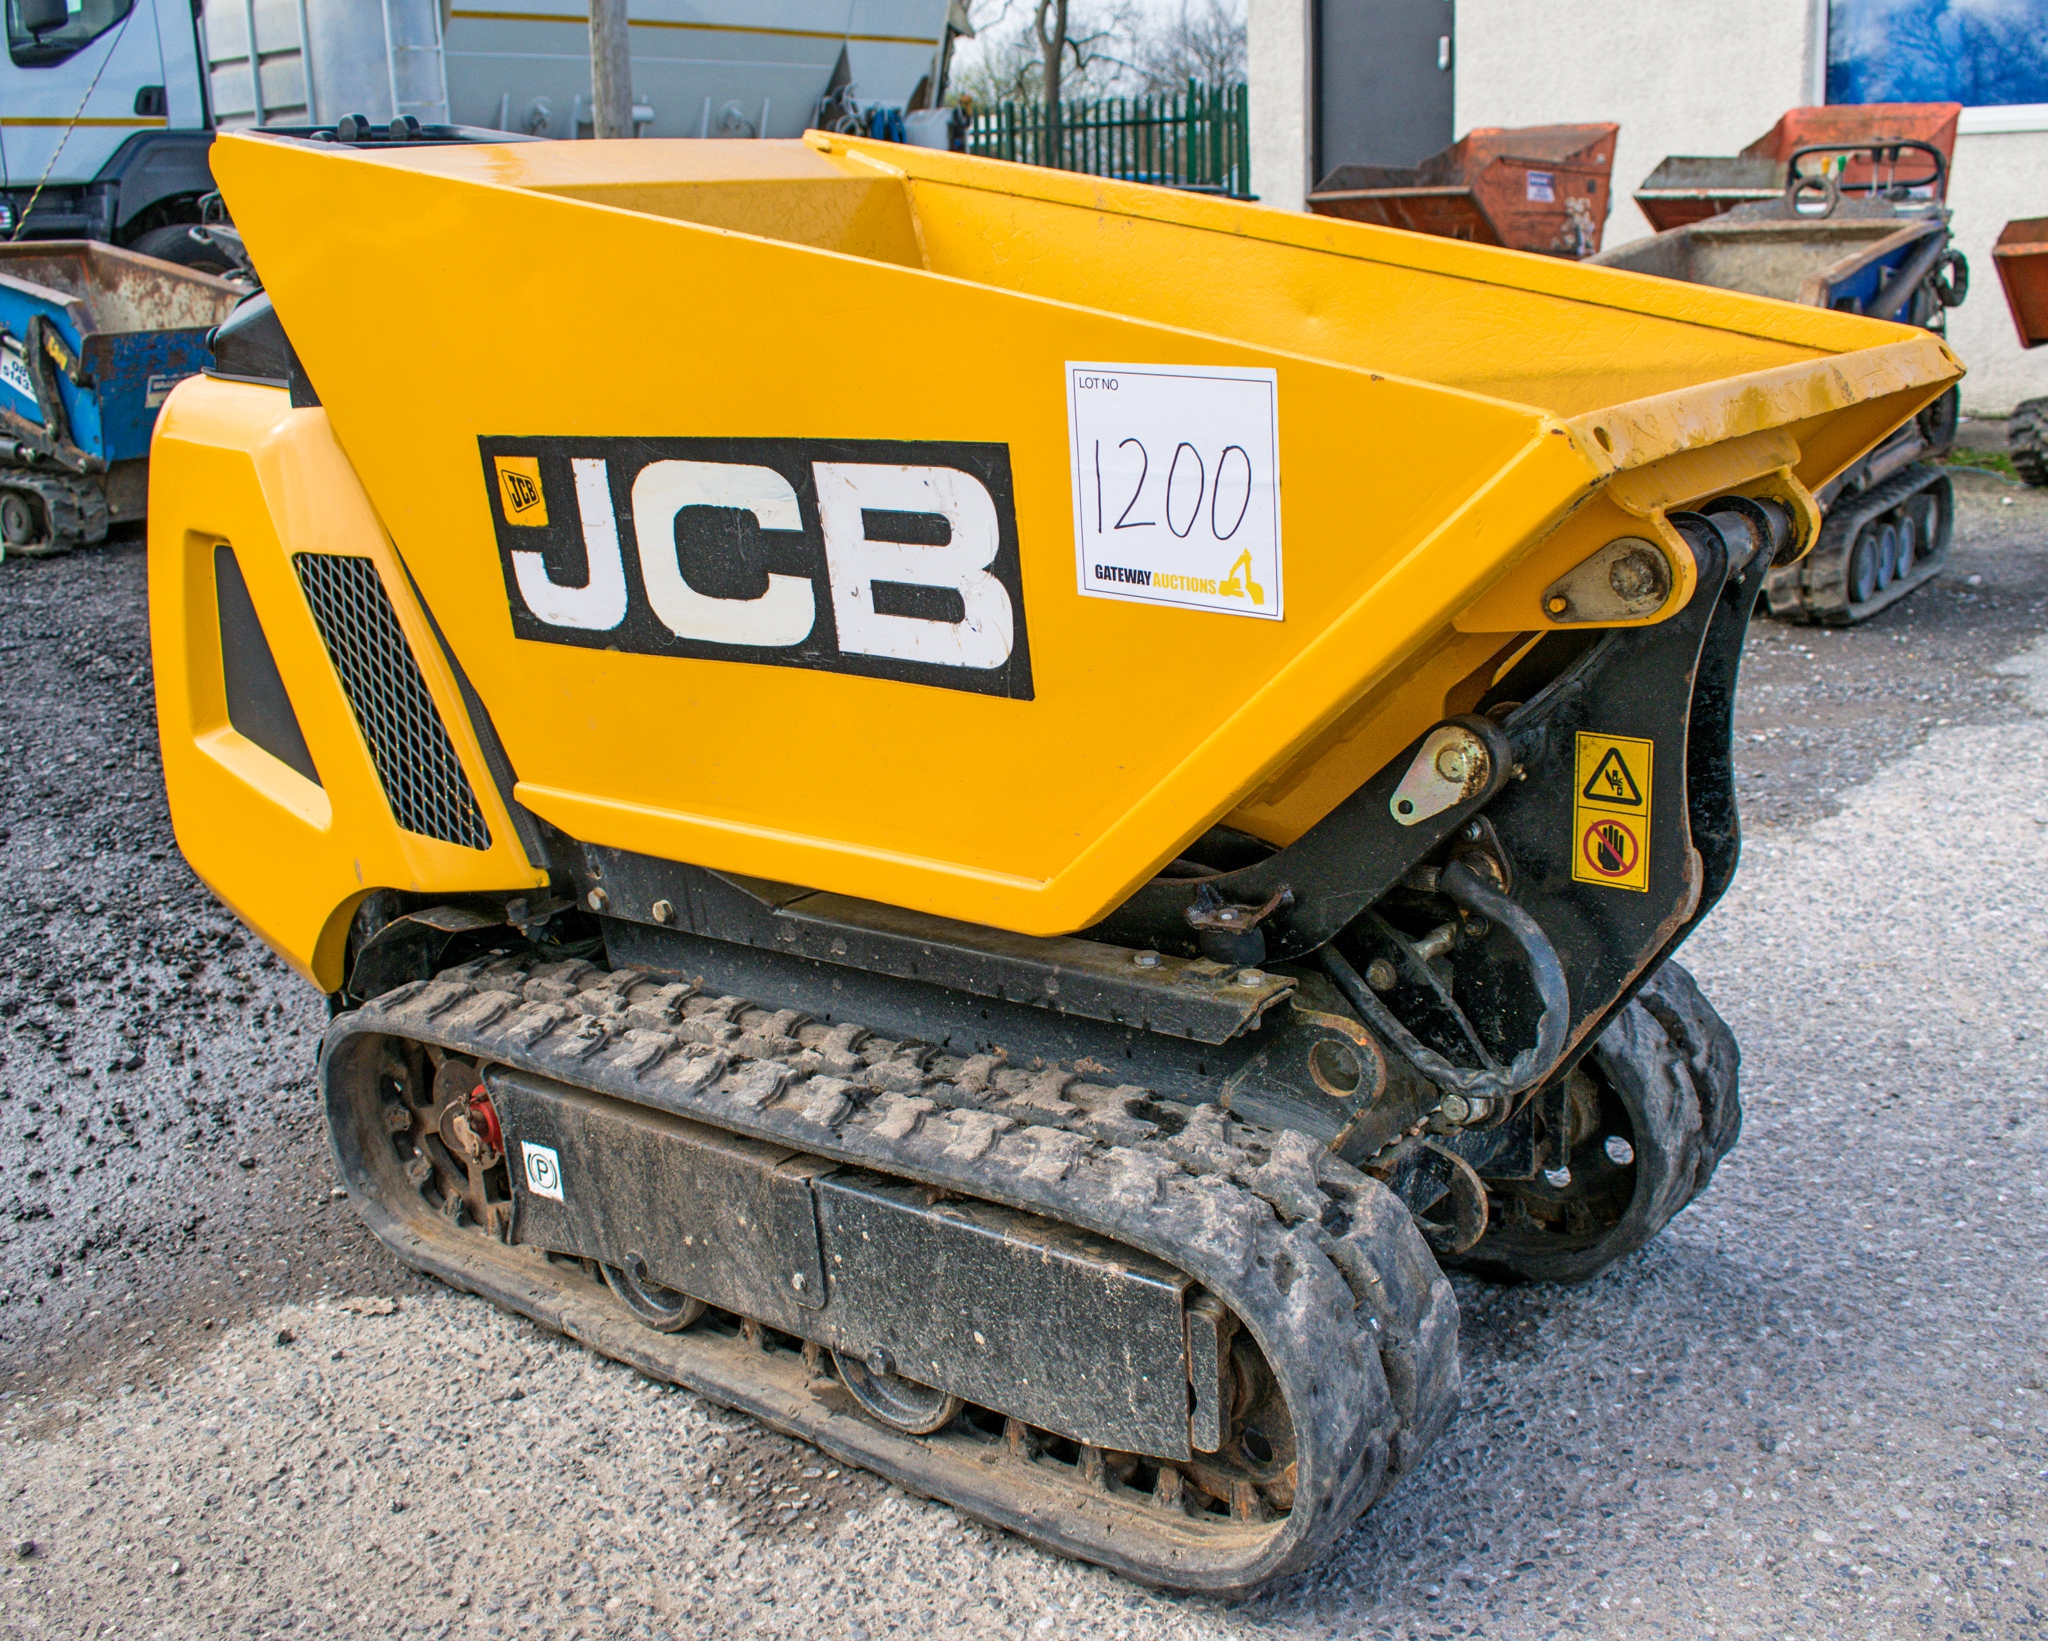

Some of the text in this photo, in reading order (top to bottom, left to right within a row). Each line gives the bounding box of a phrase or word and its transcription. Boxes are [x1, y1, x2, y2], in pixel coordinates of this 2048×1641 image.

[1079, 377, 1119, 391] LOT NO
[507, 474, 537, 508] JCB
[1095, 438, 1252, 541] 1200
[510, 455, 1014, 670] JCB
[1095, 563, 1217, 595] GATEWAY AUCTIONS
